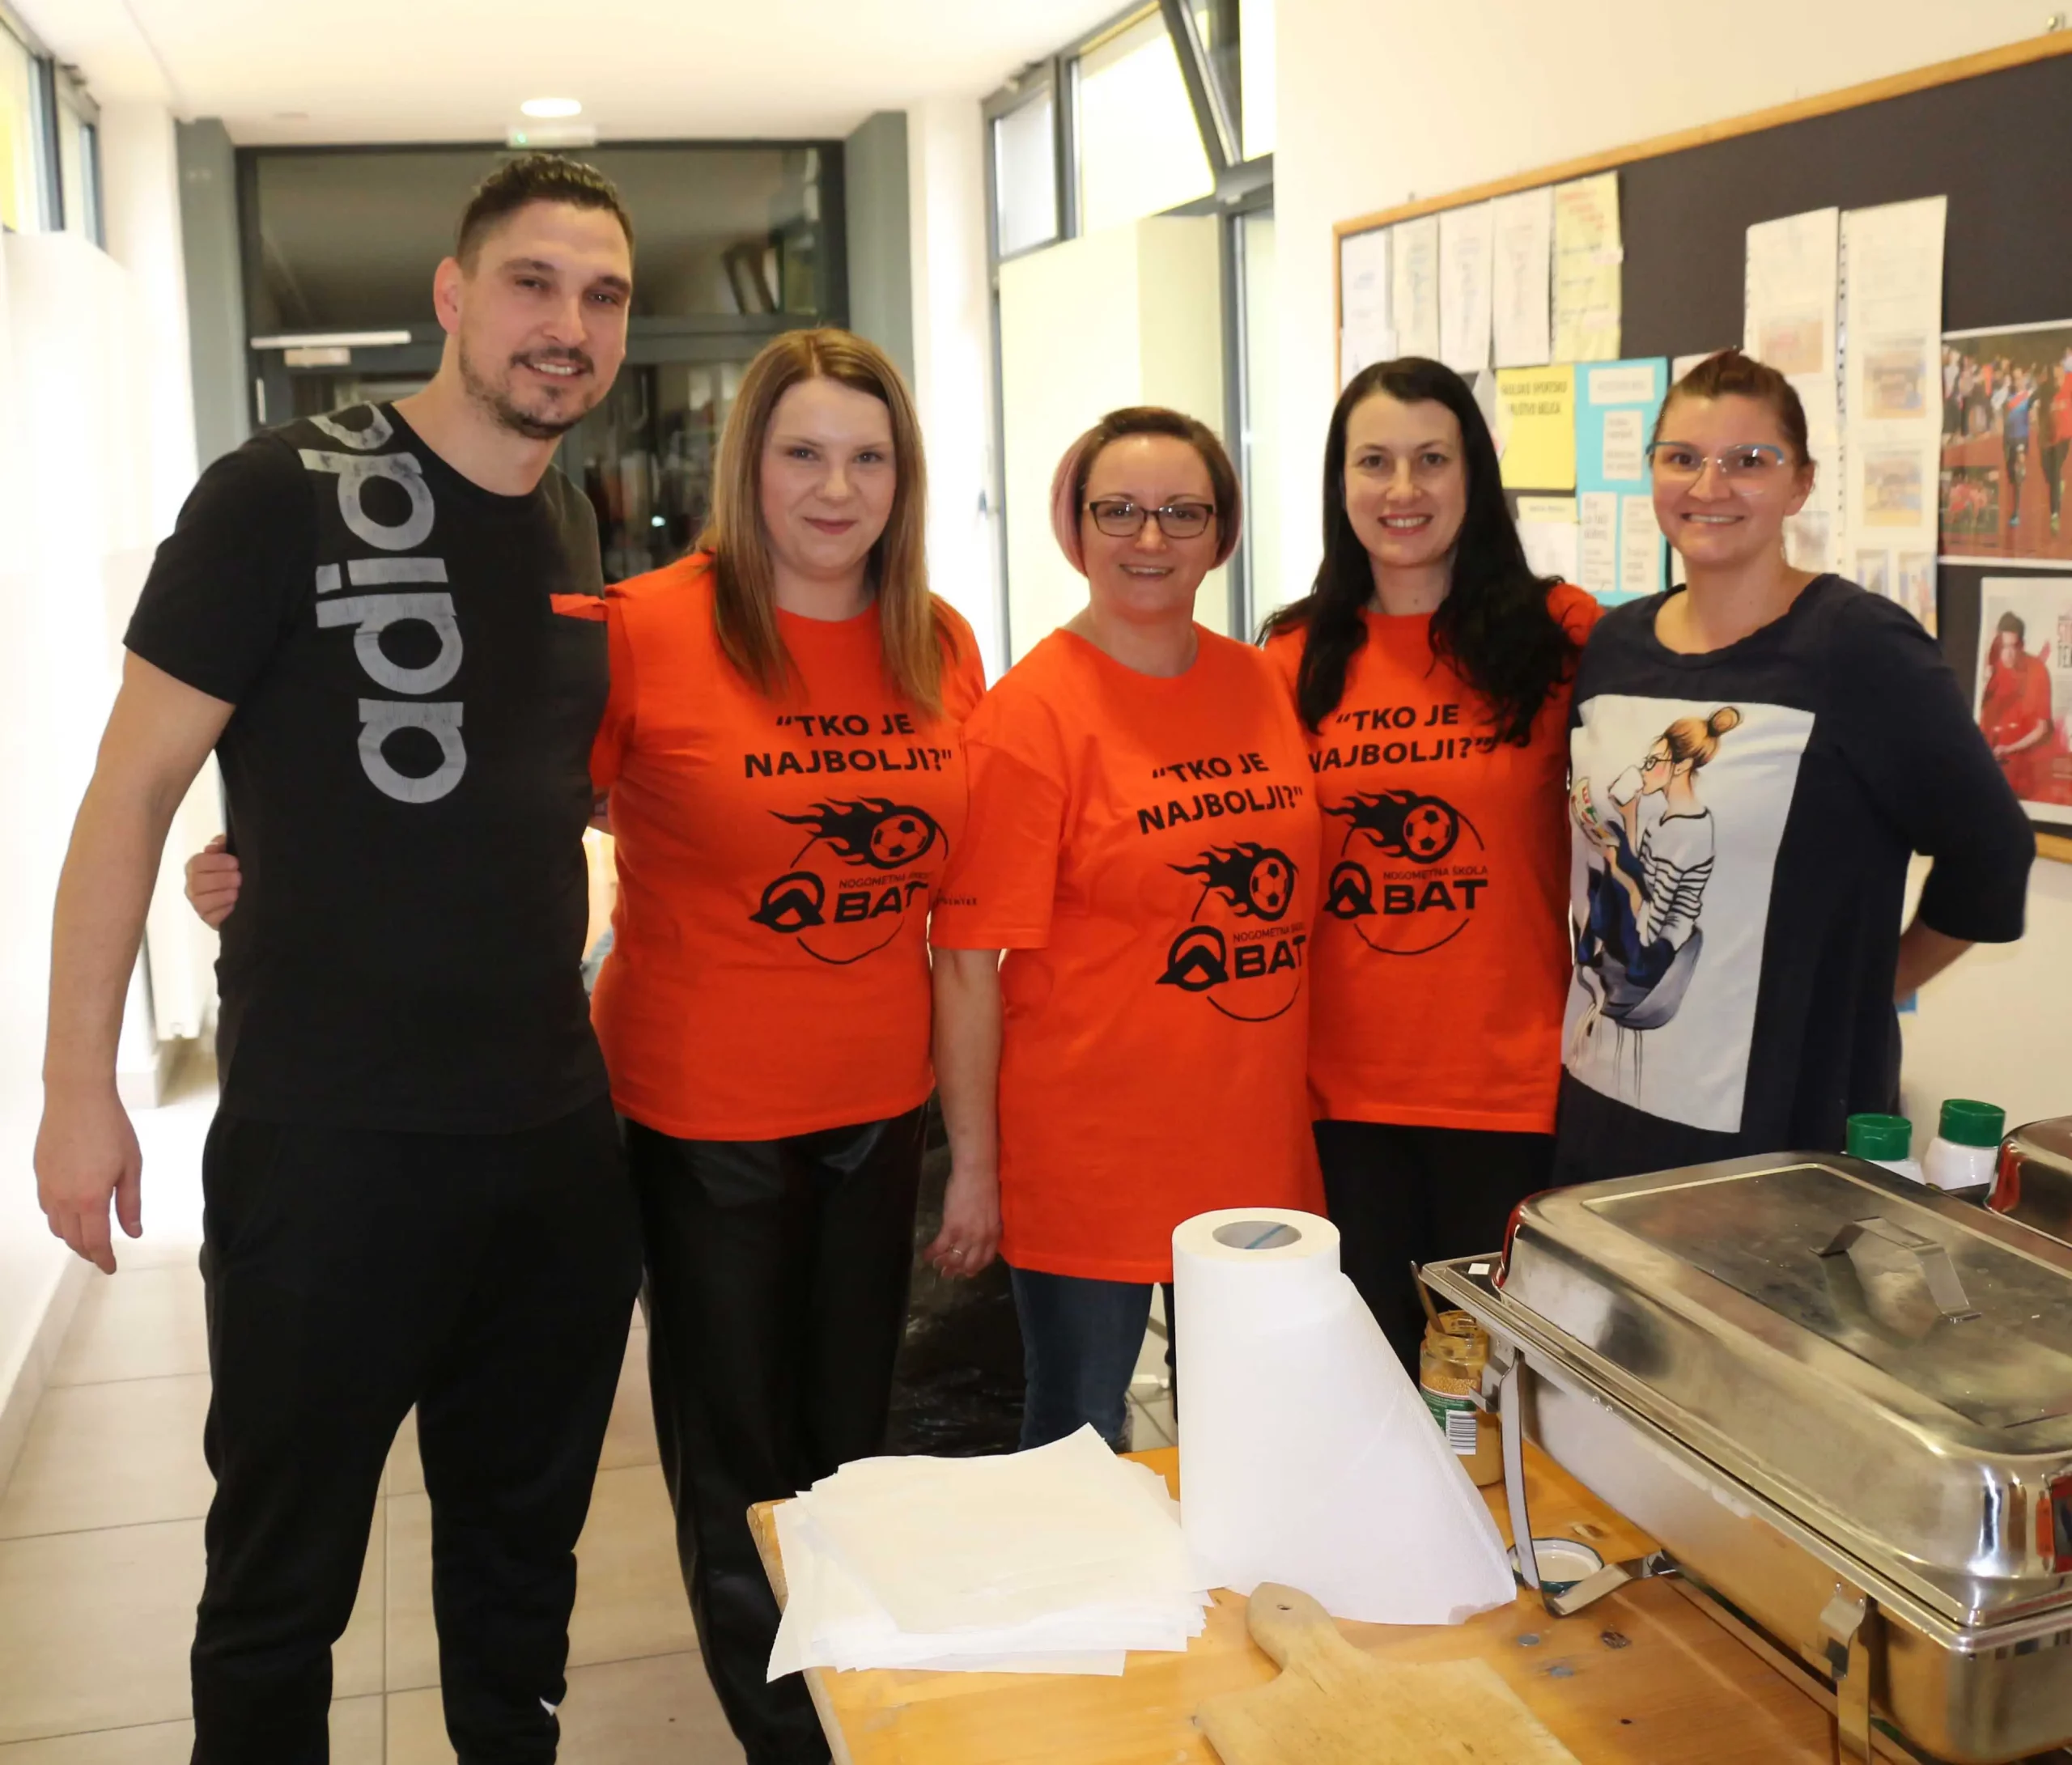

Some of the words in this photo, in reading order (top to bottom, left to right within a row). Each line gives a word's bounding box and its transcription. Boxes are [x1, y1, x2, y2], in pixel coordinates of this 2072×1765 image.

[881, 713, 915, 736] JE
[1424, 703, 1460, 727] JE
[1238, 753, 1270, 774] JE
[834, 881, 928, 923] BAT
[1383, 880, 1488, 914] BAT
[1234, 934, 1306, 979] BAT
